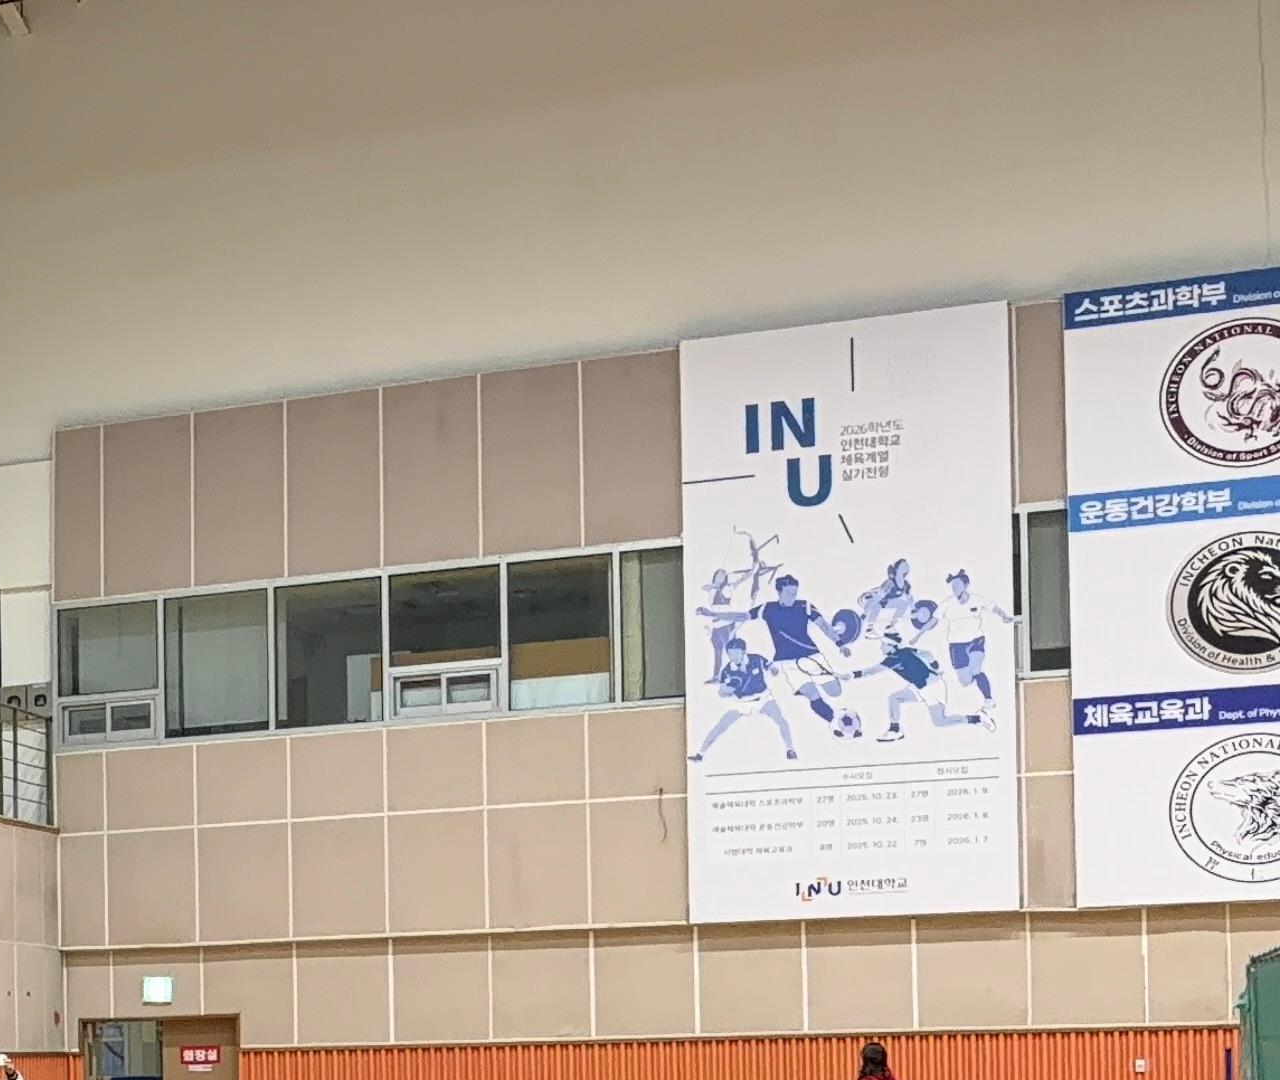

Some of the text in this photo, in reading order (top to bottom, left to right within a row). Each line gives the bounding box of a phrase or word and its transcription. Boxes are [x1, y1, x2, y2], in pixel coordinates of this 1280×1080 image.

[1073, 281, 1228, 322] 스포츠과학부
[1167, 324, 1274, 419] INCHEON NATIONAL
[840, 419, 905, 437] 2026학년도
[840, 434, 901, 451] 인천대학교
[1078, 487, 1233, 525] 운동건강학부
[1179, 536, 1244, 588] INCHEON
[1177, 617, 1276, 667] Division of Health &
[1083, 696, 1212, 728] 체육교육과
[1246, 707, 1258, 719] of
[1174, 771, 1199, 841] INCHEON
[1209, 839, 1253, 861] Physical
[795, 877, 909, 898] INU 인천대학교
